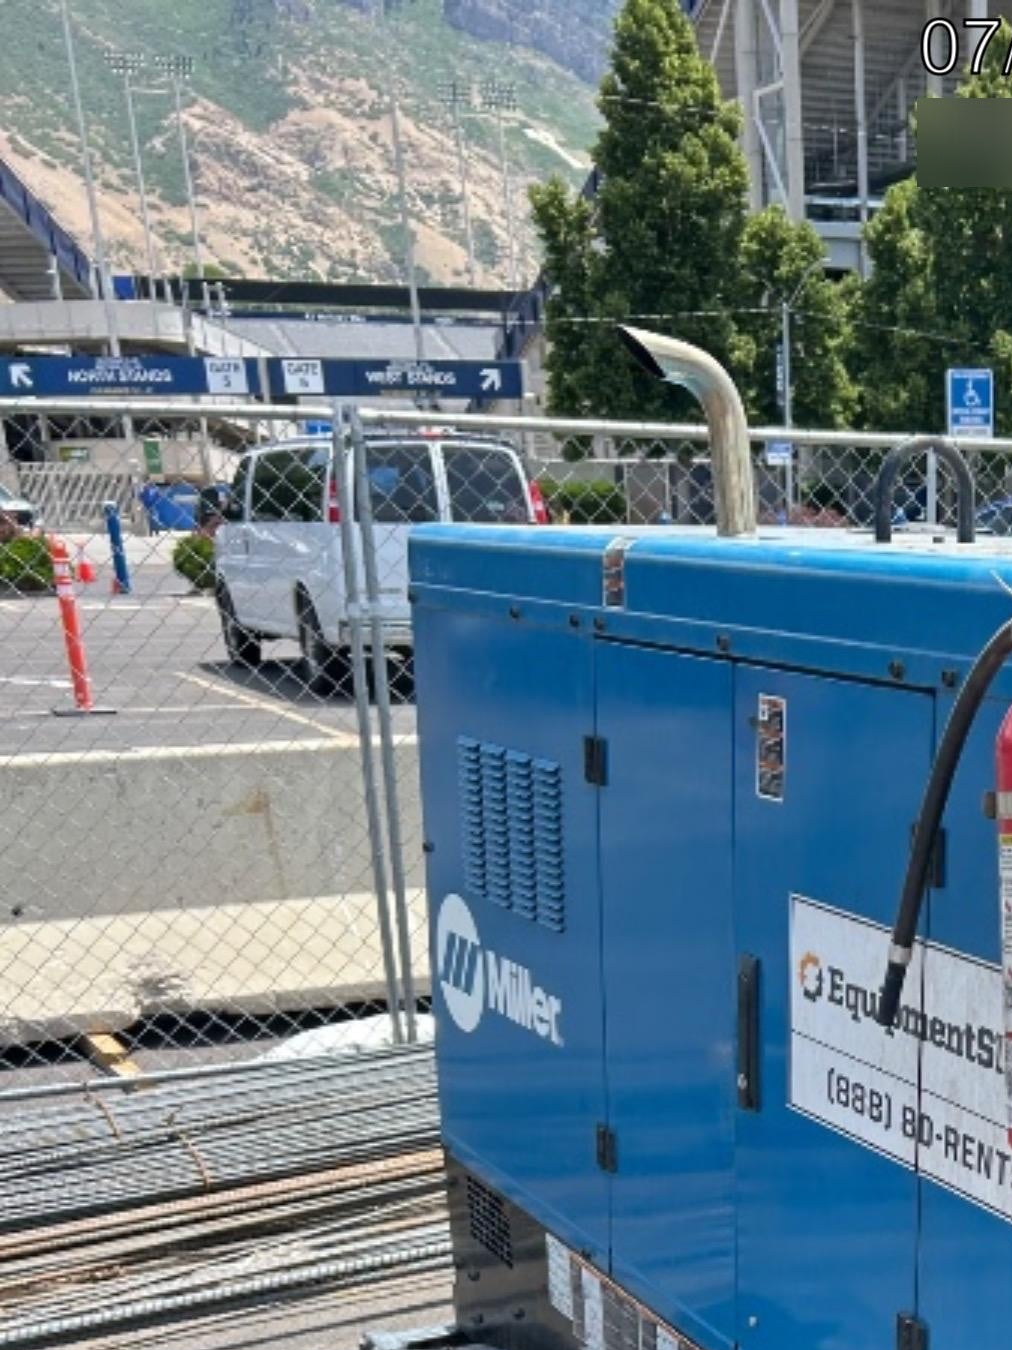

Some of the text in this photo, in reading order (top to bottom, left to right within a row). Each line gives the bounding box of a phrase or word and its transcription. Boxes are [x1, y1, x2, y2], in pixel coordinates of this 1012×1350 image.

[486, 949, 564, 1047] Miller
[827, 965, 1005, 1074] EqumentS
[827, 1066, 893, 1131] (888)
